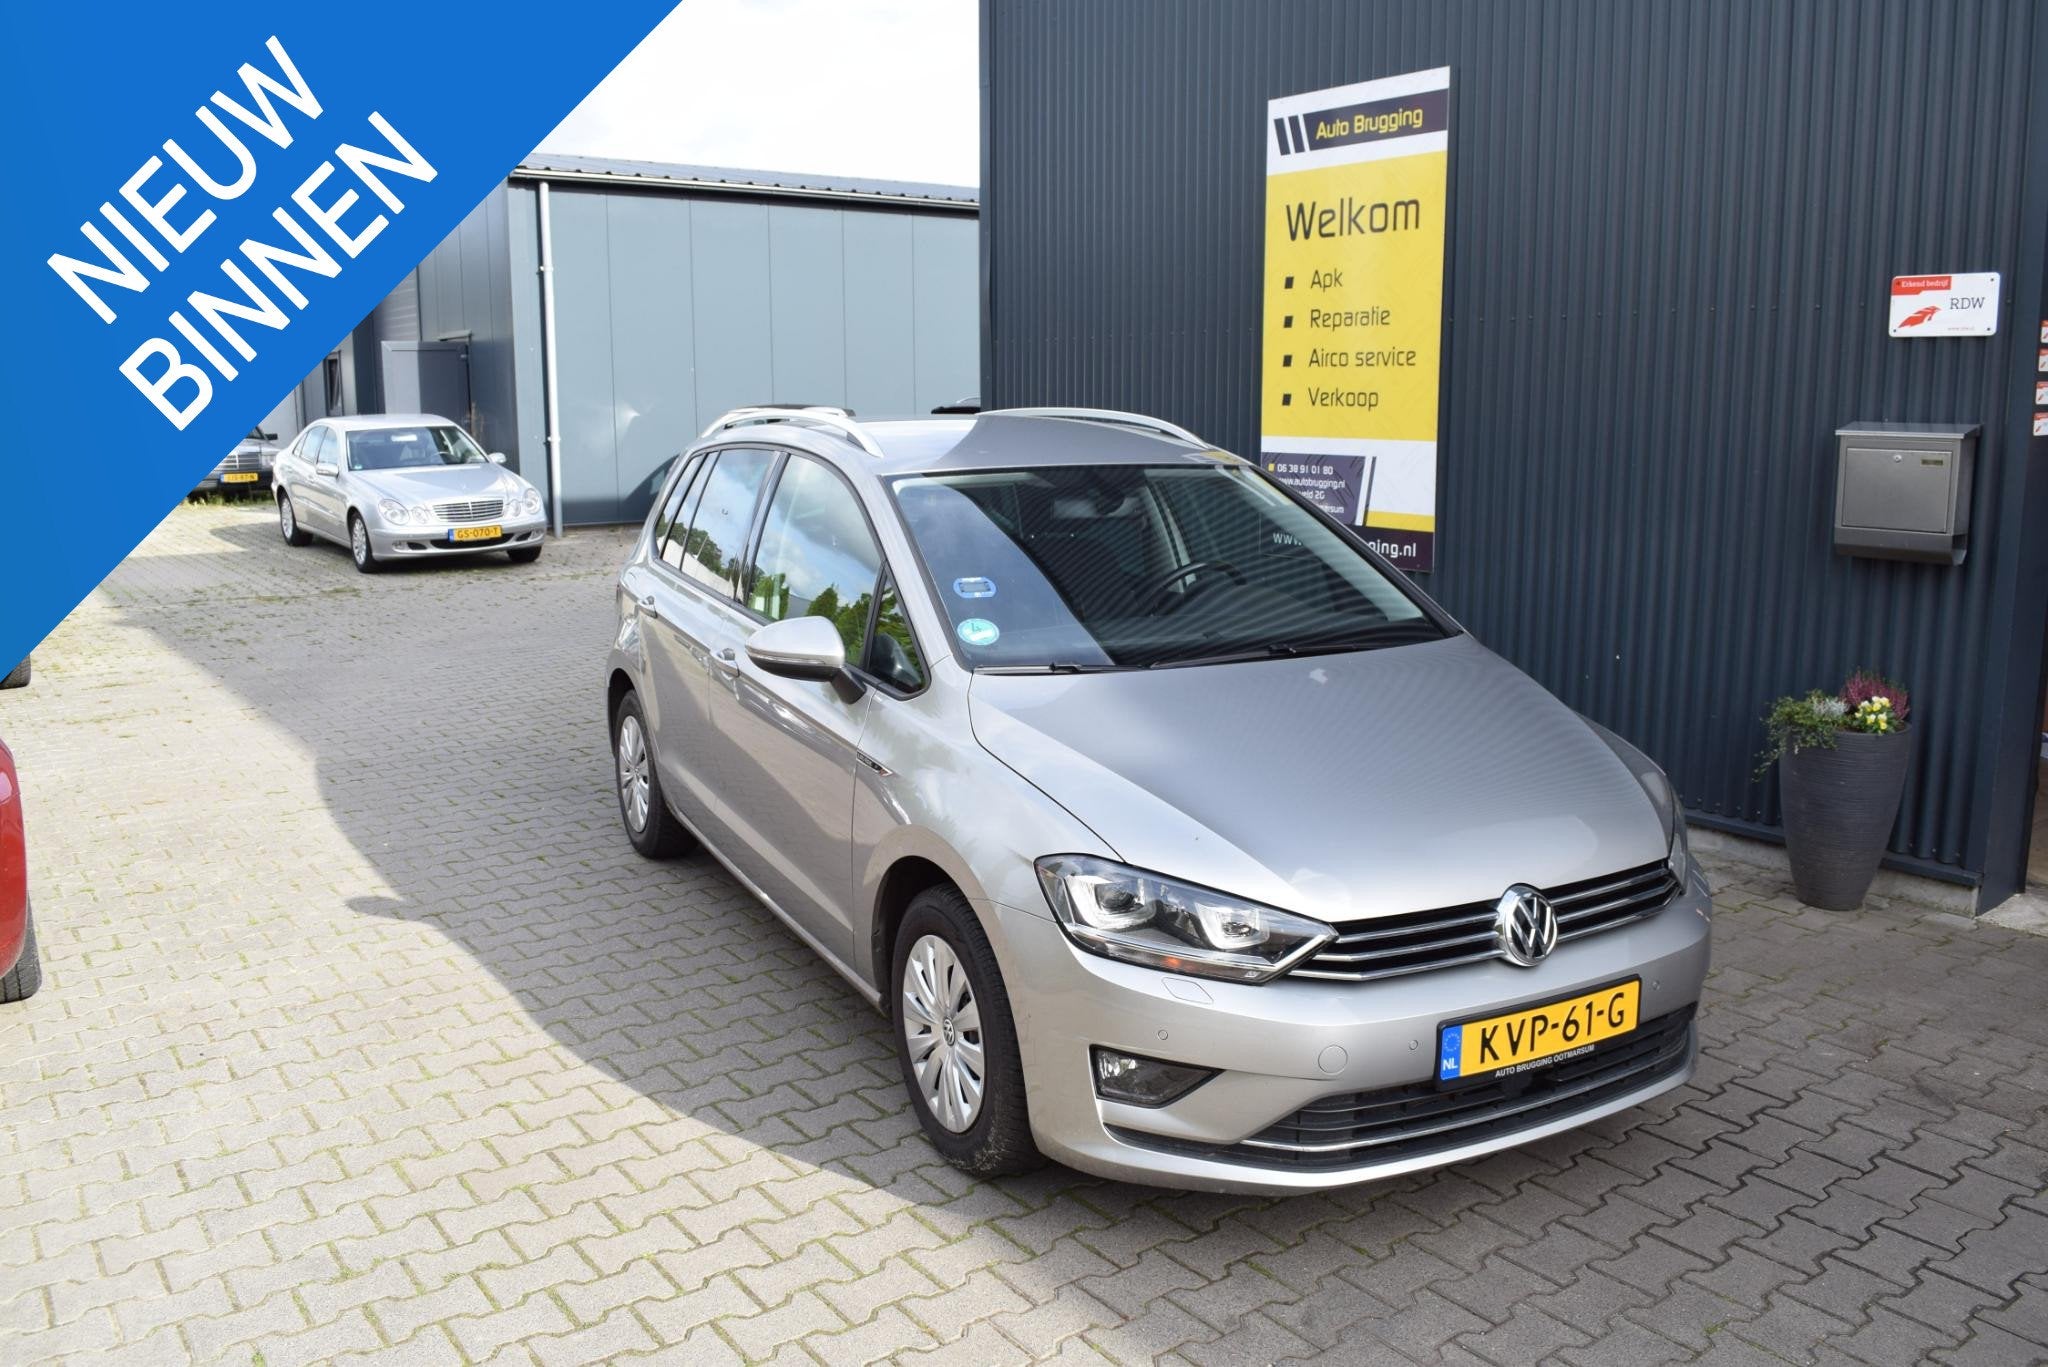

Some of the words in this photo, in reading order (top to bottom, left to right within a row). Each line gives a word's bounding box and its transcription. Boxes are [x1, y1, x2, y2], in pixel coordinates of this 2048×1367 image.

[1315, 117, 1349, 140] Auto
[1353, 108, 1423, 133] Brugging
[1286, 197, 1420, 242] Welkom
[1310, 268, 1343, 291] Apk
[1901, 280, 1925, 288] Erkend
[1926, 279, 1949, 288] bedrijf
[1950, 297, 1985, 310] RDW
[1310, 307, 1391, 332] Reparatie
[1308, 348, 1349, 369] Airco
[1355, 349, 1417, 367] service
[1308, 387, 1379, 411] Verkoop
[1277, 463, 1287, 473] 06
[1479, 992, 1625, 1064] KVP-61-G
[1442, 1057, 1458, 1071] NL
[1495, 1066, 1516, 1078] AUTO
[1516, 1056, 1553, 1073] BRUGGING
[1553, 1044, 1595, 1063] OOTMARSUM
